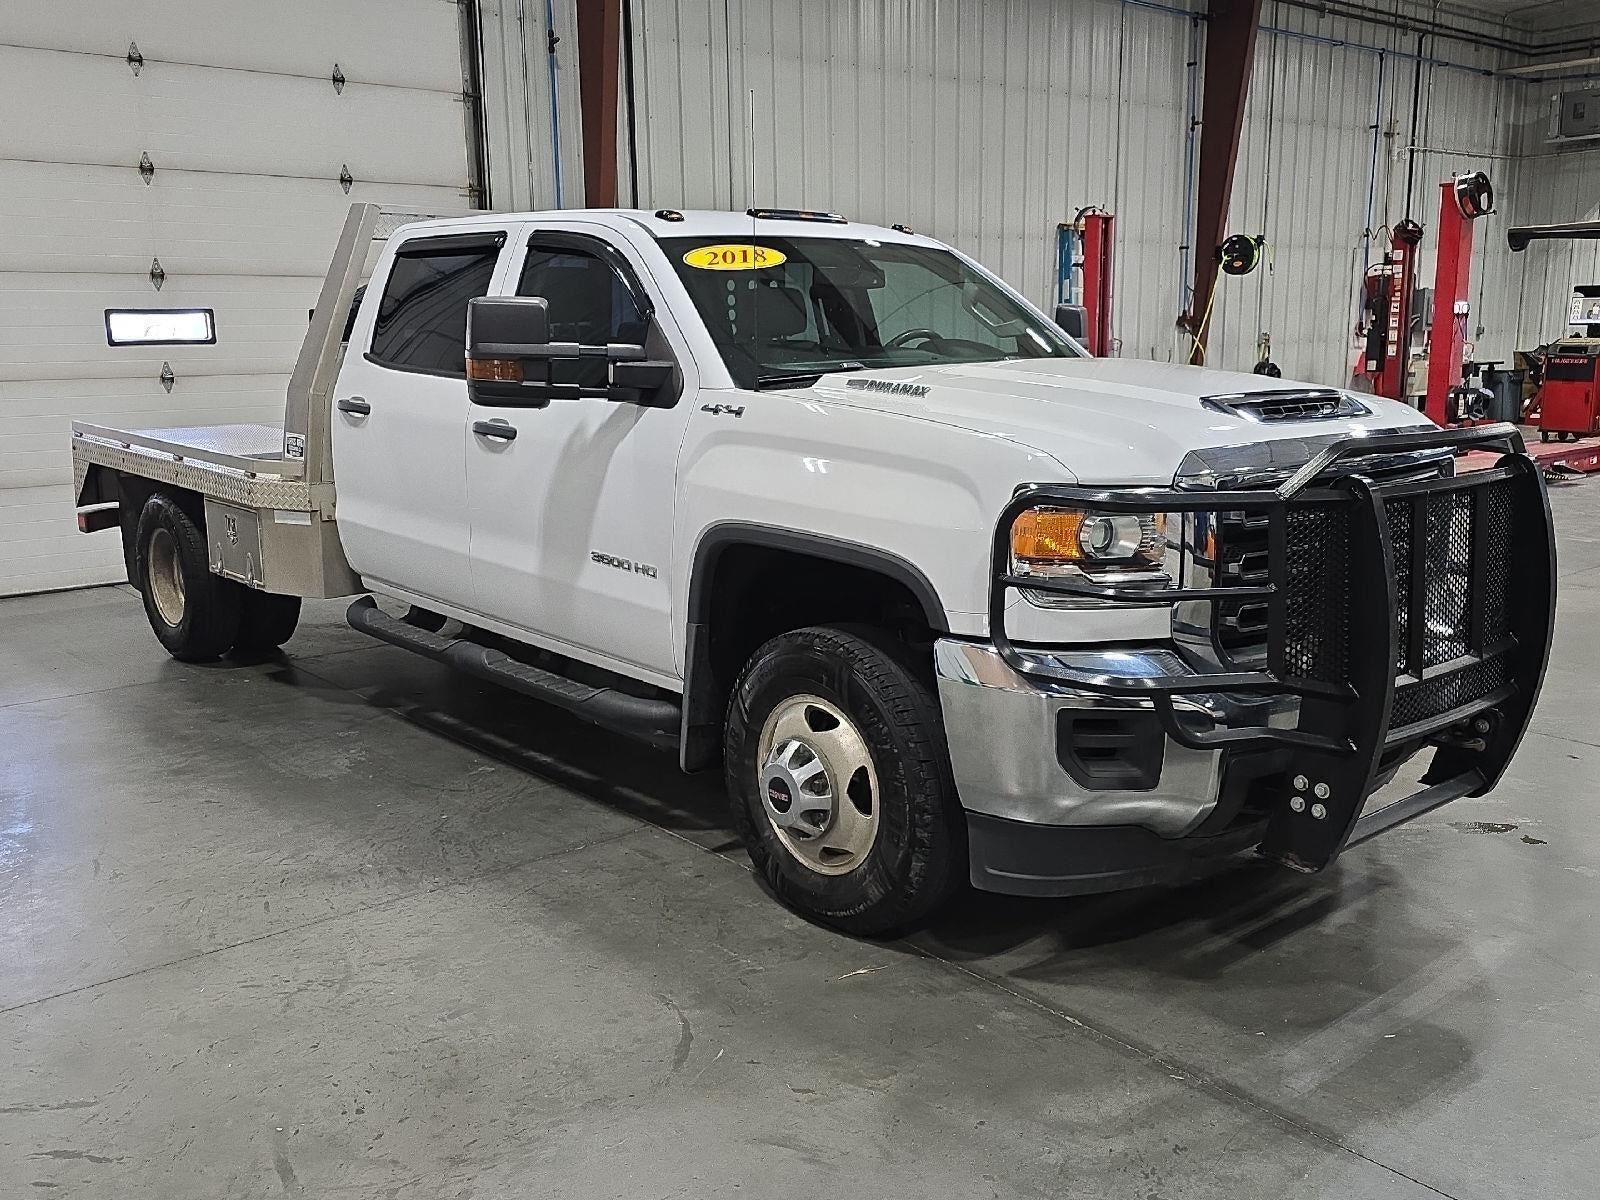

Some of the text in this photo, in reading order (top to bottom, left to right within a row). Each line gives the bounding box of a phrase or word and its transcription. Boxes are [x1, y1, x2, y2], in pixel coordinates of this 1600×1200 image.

[705, 249, 767, 266] 2018
[866, 380, 931, 398] DURAMAX
[590, 551, 658, 579] 3500 HD
